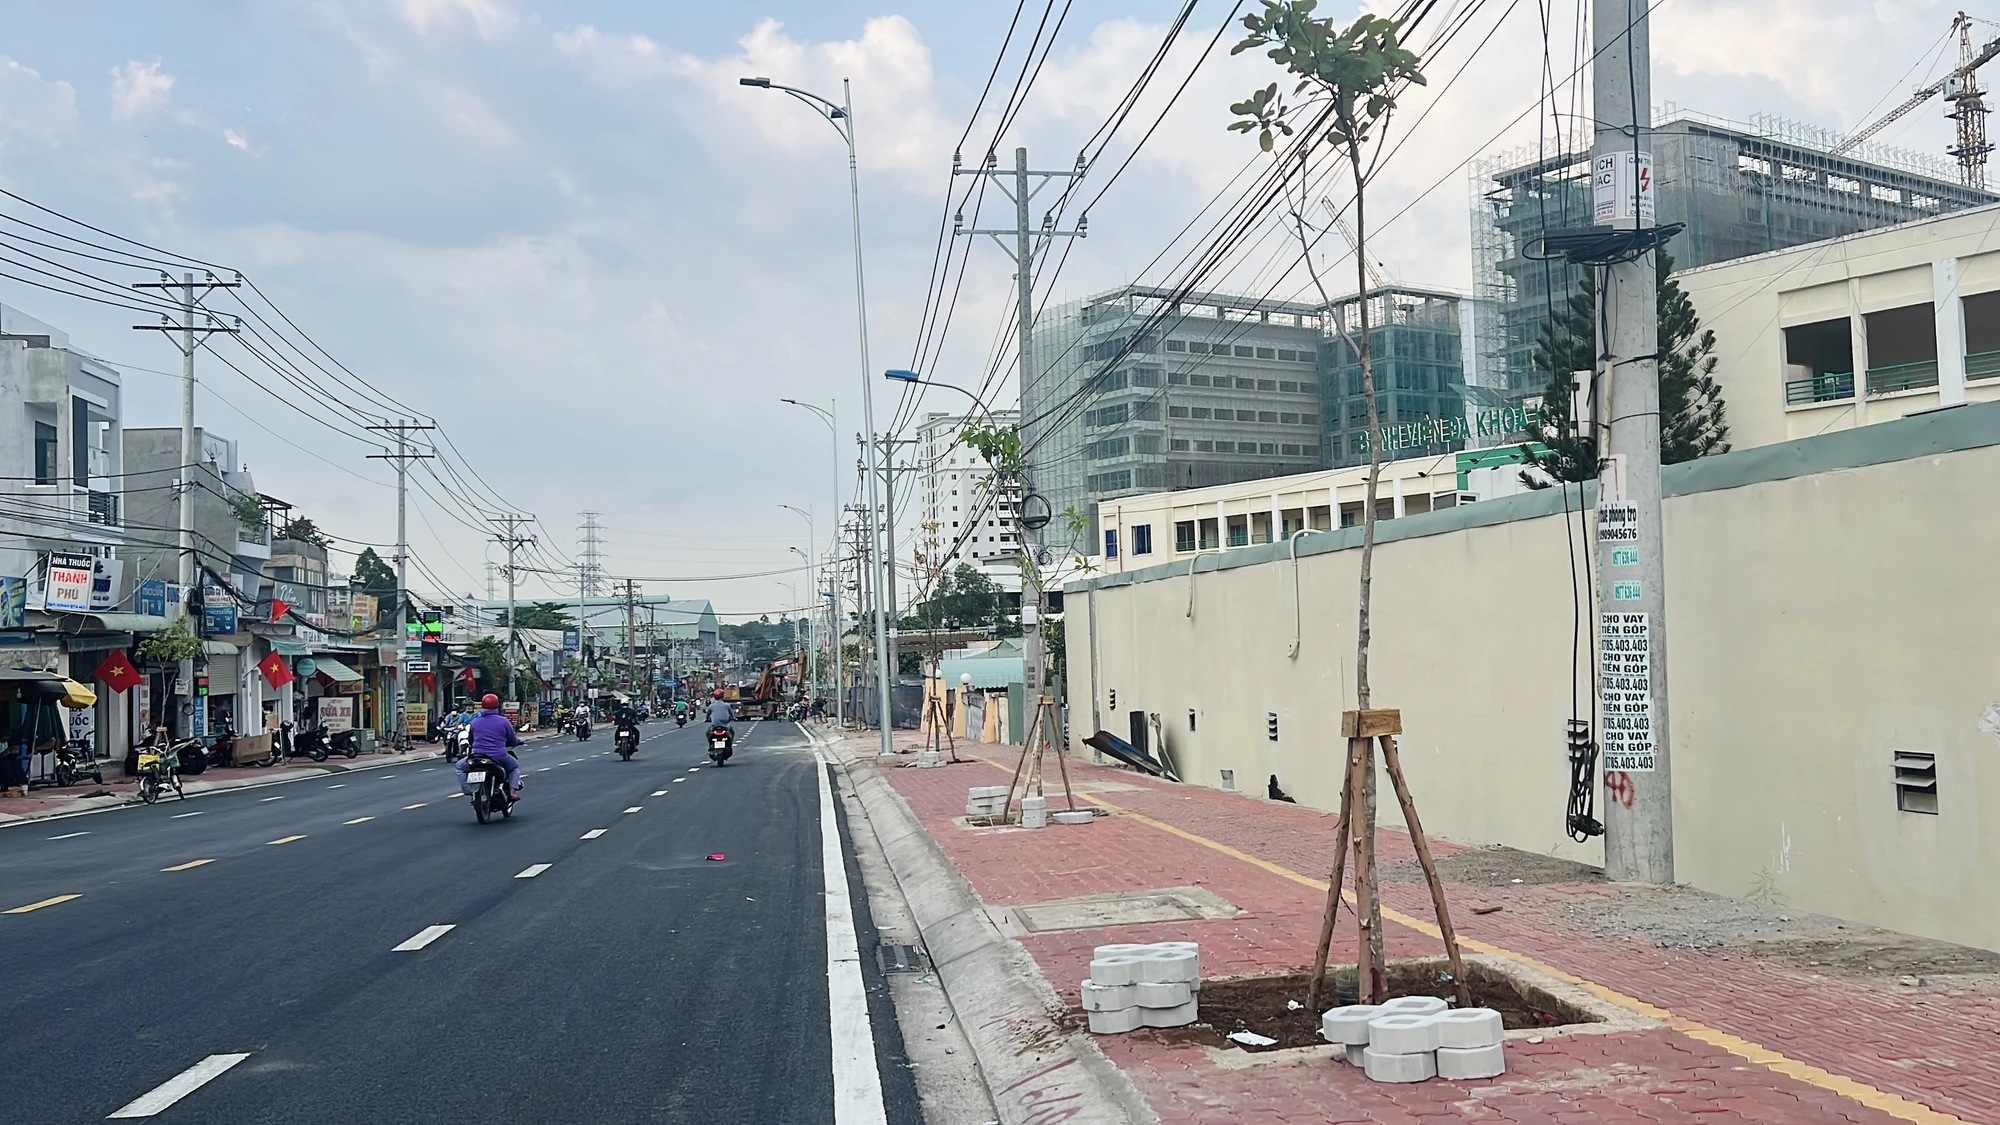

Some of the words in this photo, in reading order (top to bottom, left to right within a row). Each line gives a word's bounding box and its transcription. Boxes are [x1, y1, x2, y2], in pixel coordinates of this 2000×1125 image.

[69, 557, 91, 567] THUỐC
[57, 587, 79, 600] PHÚ
[1602, 615, 1620, 623] CHO
[1623, 615, 1644, 623] VAY
[1623, 623, 1647, 634] GÓP
[1603, 653, 1621, 662] CHO
[1625, 654, 1645, 662] VAY
[1624, 663, 1648, 673] GÓP
[1604, 693, 1621, 701] CHO
[1624, 693, 1645, 701] VAY
[1624, 703, 1649, 712] GÓP
[1606, 732, 1624, 740] CHO
[1628, 732, 1648, 740] VAY
[1628, 741, 1652, 751] GÓP
